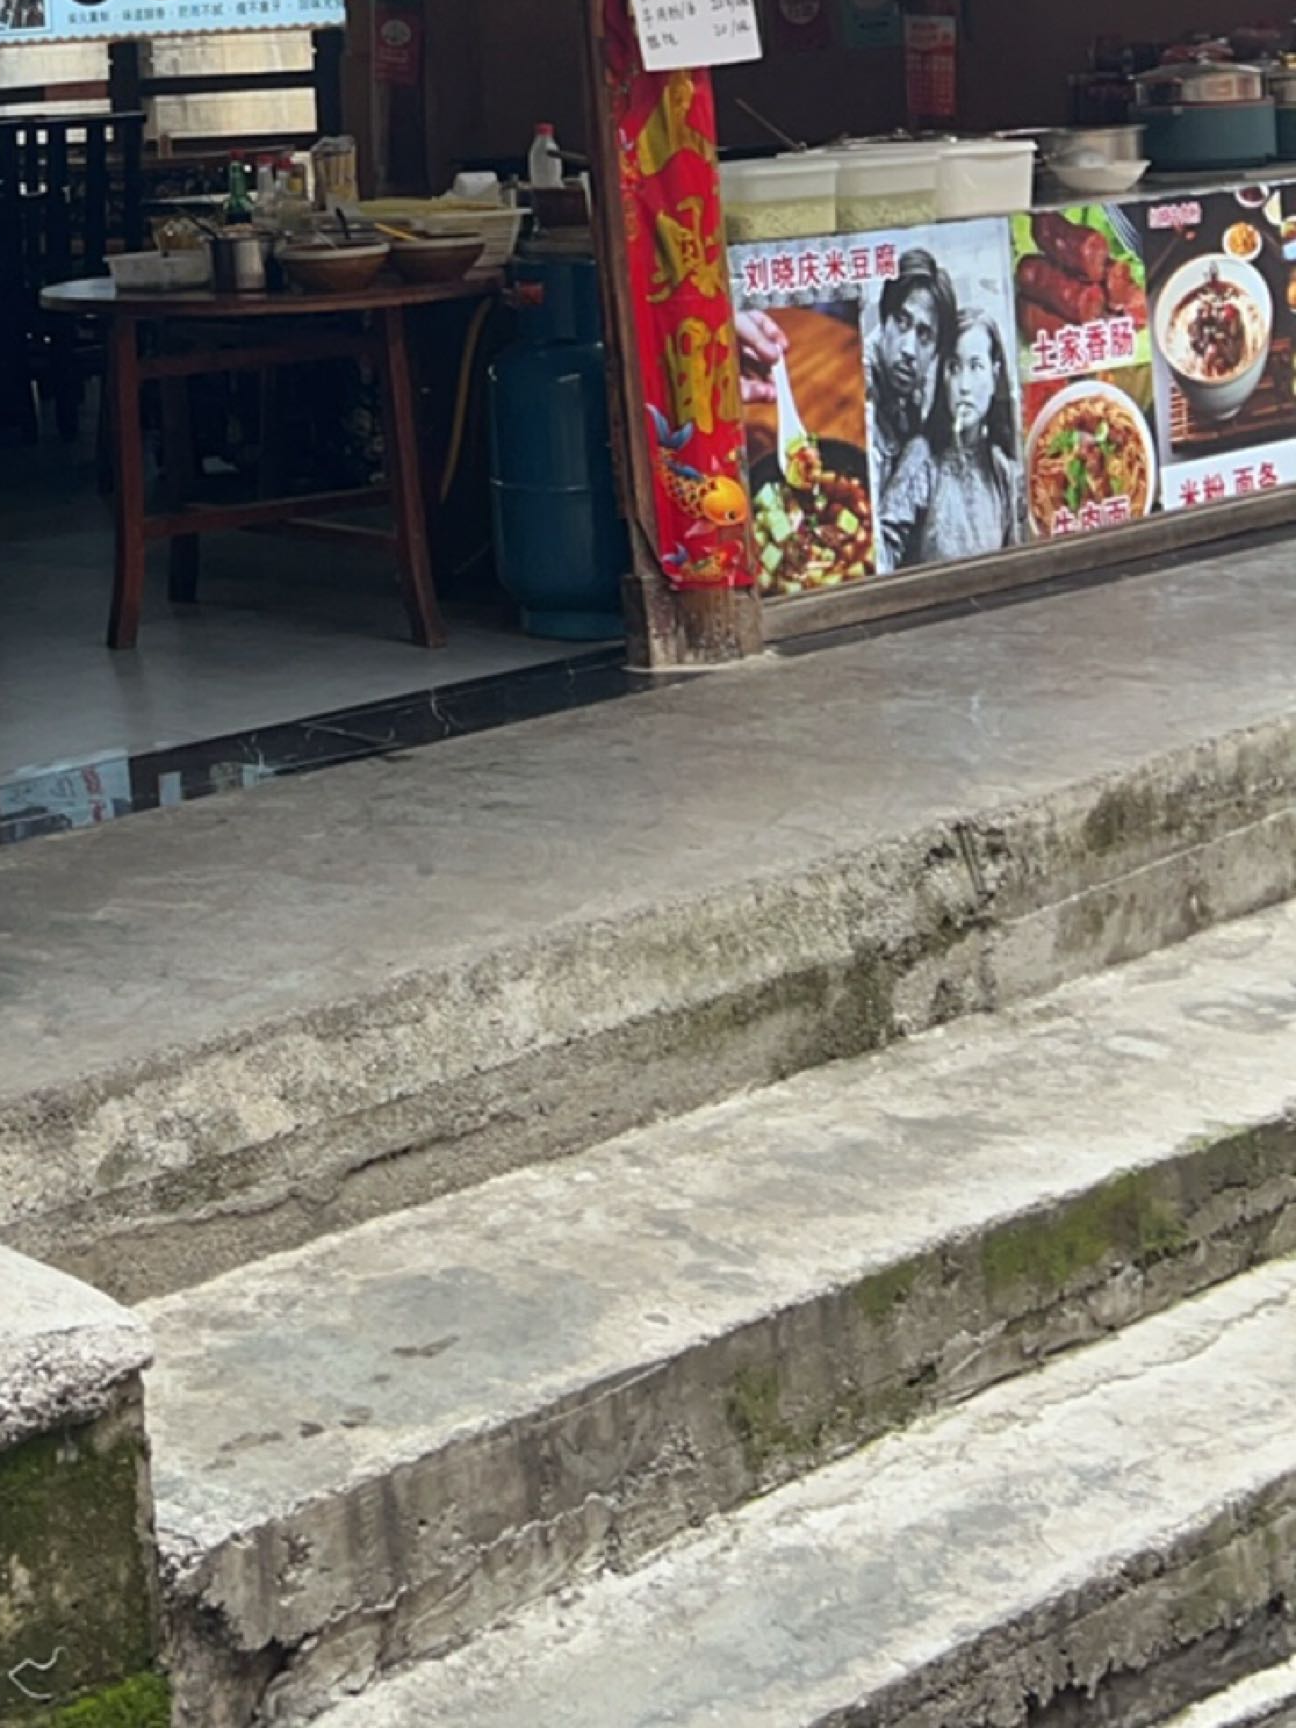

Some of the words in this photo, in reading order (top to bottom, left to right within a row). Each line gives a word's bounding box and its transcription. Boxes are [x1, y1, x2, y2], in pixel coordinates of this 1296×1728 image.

[743, 242, 898, 293] 刘晓庆米豆腐
[1031, 319, 1135, 373] 土家香肠
